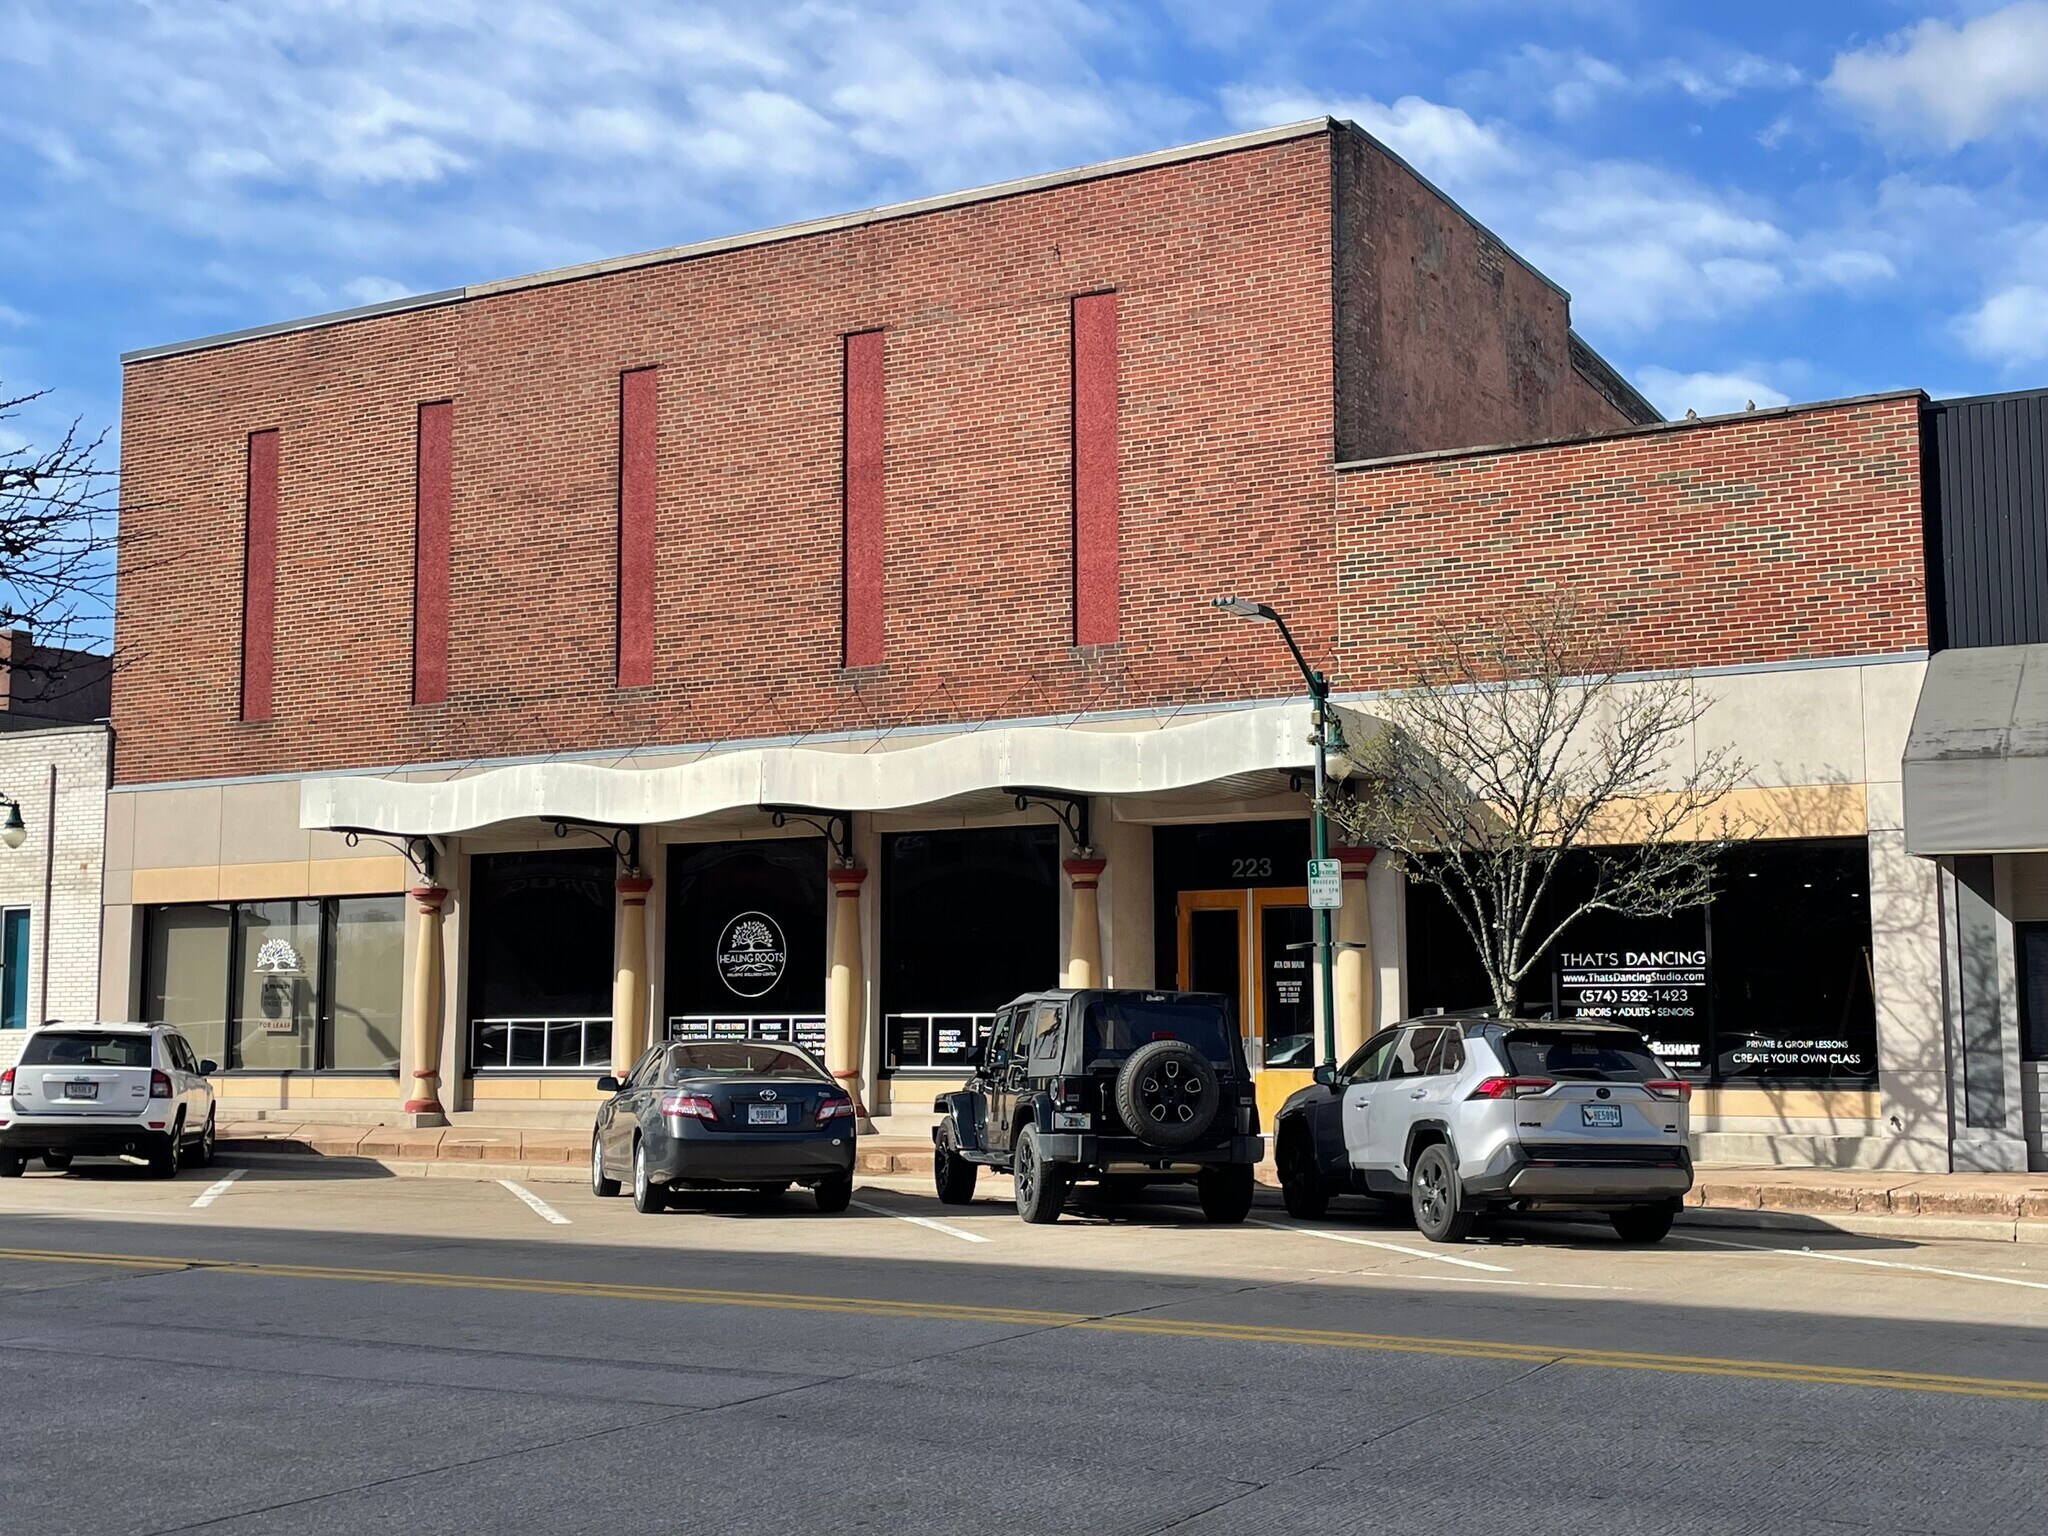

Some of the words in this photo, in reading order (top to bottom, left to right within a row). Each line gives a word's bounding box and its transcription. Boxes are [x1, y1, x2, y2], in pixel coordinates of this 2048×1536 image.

[1232, 858, 1272, 878] 223
[1311, 862, 1318, 876] 3
[719, 953, 754, 964] HEALING
[754, 952, 784, 963] ROOTS
[1561, 953, 1619, 967] THAT'S
[1626, 951, 1706, 966] DANCING
[1562, 972, 1705, 983] www.ThatsDancingStudio.com
[1580, 990, 1618, 1003] (574)
[1621, 989, 1688, 1002] 522-1423
[1575, 1008, 1612, 1017] JUNIORS
[1618, 1008, 1651, 1016] ADULTS
[1657, 1007, 1695, 1016] SENIORS
[1653, 1041, 1701, 1055] ELKHART
[1785, 1040, 1813, 1048] GROUP
[1815, 1040, 1849, 1048] LESSONS
[1732, 1053, 1769, 1063] CREATE
[1771, 1053, 1799, 1063] YOUR
[1800, 1053, 1827, 1063] OWN
[1829, 1053, 1861, 1063] CLASS
